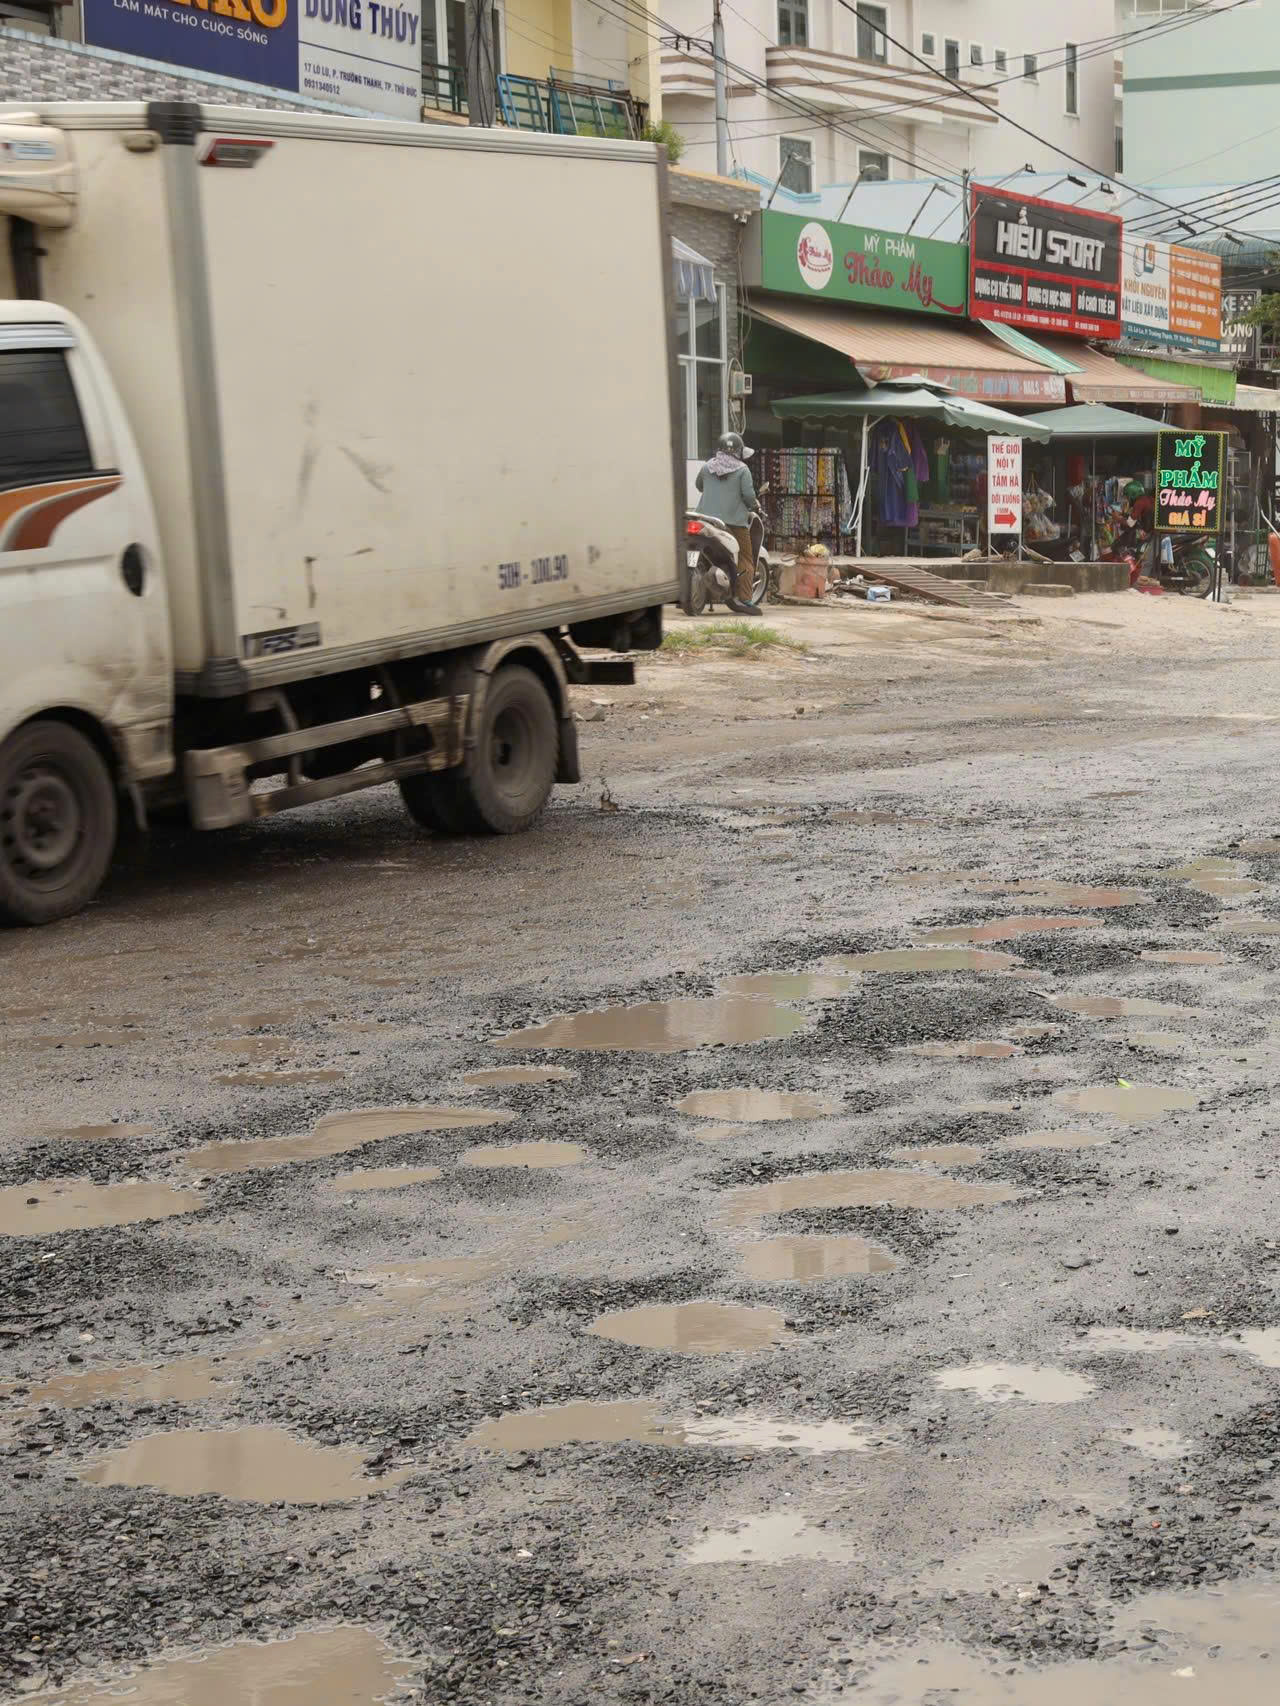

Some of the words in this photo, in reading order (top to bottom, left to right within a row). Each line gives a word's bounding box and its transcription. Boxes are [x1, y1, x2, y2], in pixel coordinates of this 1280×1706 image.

[172, 11, 198, 27] CHO
[368, 2, 419, 45] THÚY
[1045, 229, 1105, 272] SPORT
[1175, 434, 1207, 458] MỸ
[1010, 459, 1015, 469] Y
[1160, 460, 1219, 489] PHẨM
[1193, 489, 1216, 511] My
